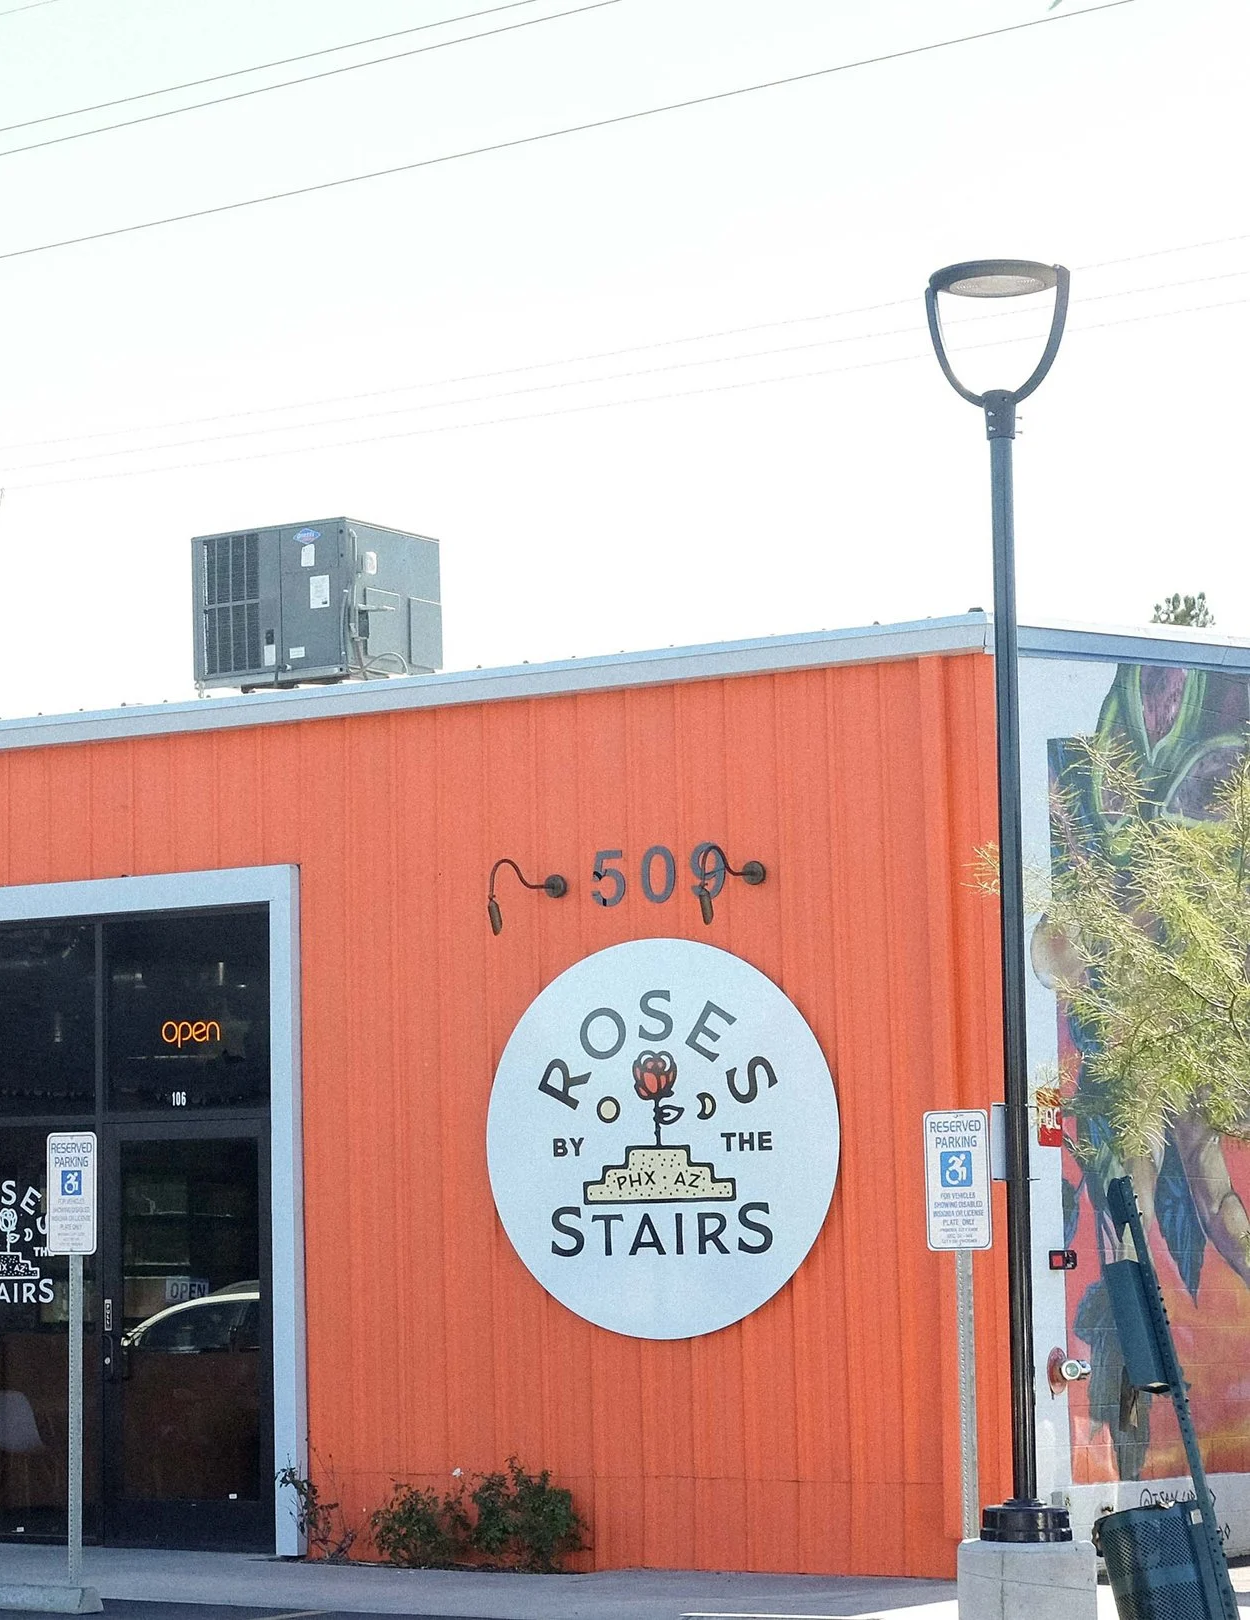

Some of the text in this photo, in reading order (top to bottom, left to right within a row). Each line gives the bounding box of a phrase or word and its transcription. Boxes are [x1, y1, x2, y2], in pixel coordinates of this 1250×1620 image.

[592, 842, 726, 907] 509
[162, 1021, 220, 1048] open
[538, 990, 778, 1110] ROSES
[172, 1091, 187, 1106] 106
[930, 1120, 981, 1133] RESERVED
[51, 1142, 92, 1153] RESERVED
[553, 1131, 773, 1157] BY THE
[935, 1135, 978, 1148] PARKING
[54, 1156, 89, 1168] PARKING
[617, 1171, 701, 1190] PHX AZ
[551, 1202, 774, 1257] STAIRS
[33, 1246, 54, 1257] TH
[170, 1282, 206, 1300] OPEN
